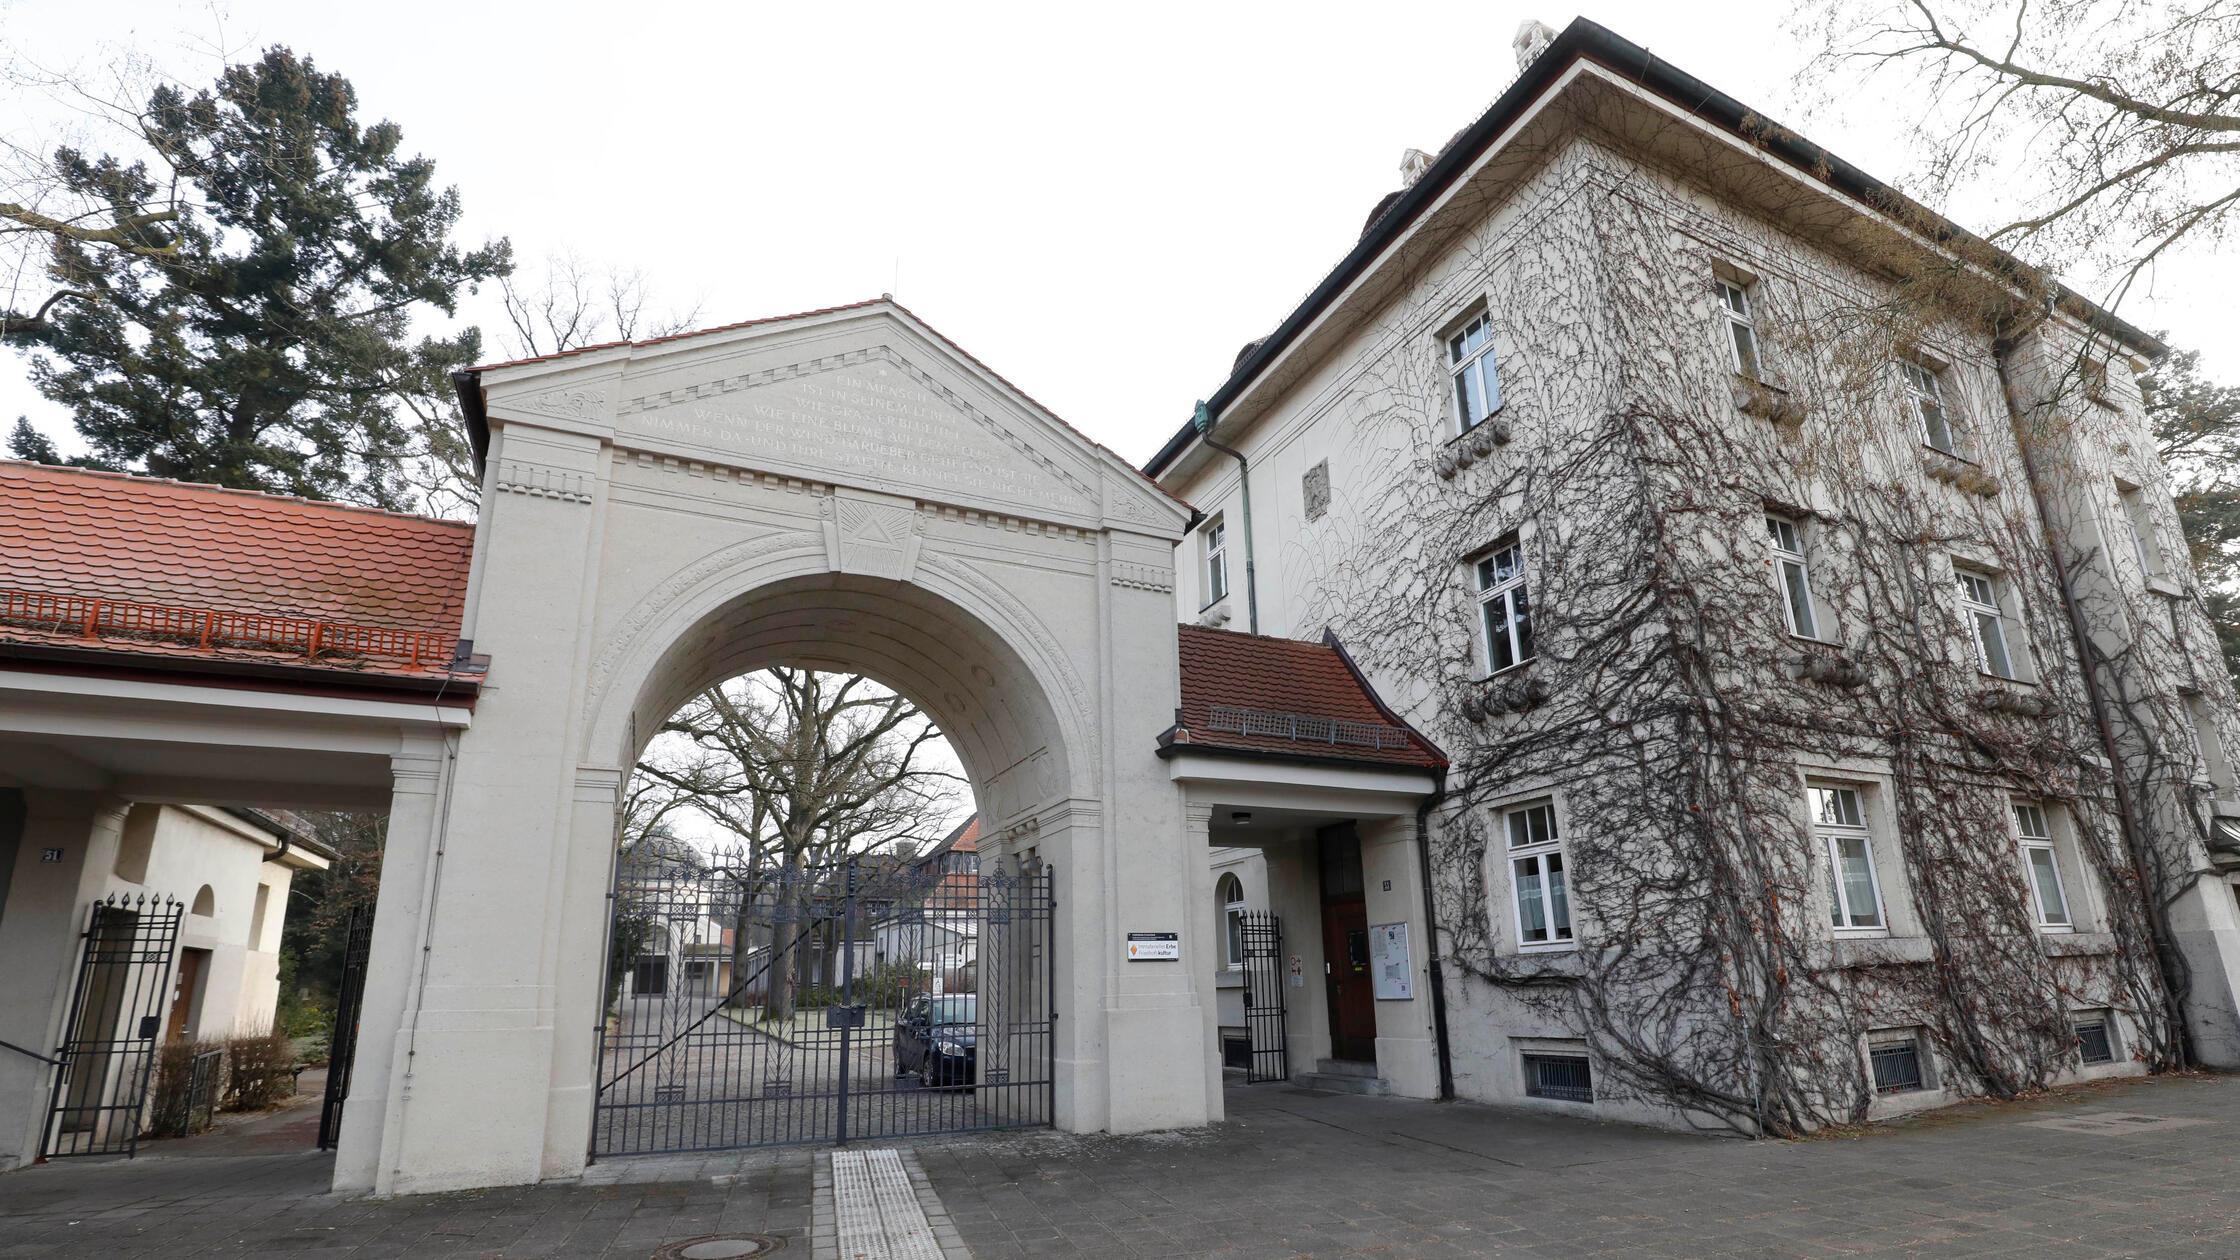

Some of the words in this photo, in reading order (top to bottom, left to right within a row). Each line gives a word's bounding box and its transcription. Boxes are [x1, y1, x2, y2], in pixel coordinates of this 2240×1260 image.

[803, 383, 824, 396] IST
[831, 389, 847, 401] IN
[851, 393, 908, 414] SEINEM
[836, 375, 862, 388] EIN
[866, 382, 927, 402] MENSCH
[794, 396, 826, 413] WIE
[754, 404, 785, 418] WIE
[791, 412, 832, 429] EINE
[834, 421, 883, 439] BLUME
[889, 431, 913, 446] AUF
[641, 414, 713, 438] NIMMER
[792, 444, 825, 459] IHRE
[835, 451, 897, 473] STAETTE
[902, 464, 958, 482] KENNET
[992, 481, 1033, 497] NICHT
[694, 407, 748, 427] WENN
[755, 421, 785, 436] DER
[790, 427, 835, 445] WIND
[842, 438, 916, 460] DARUEBER
[997, 467, 1016, 480] IST
[44, 850, 58, 860] 51
